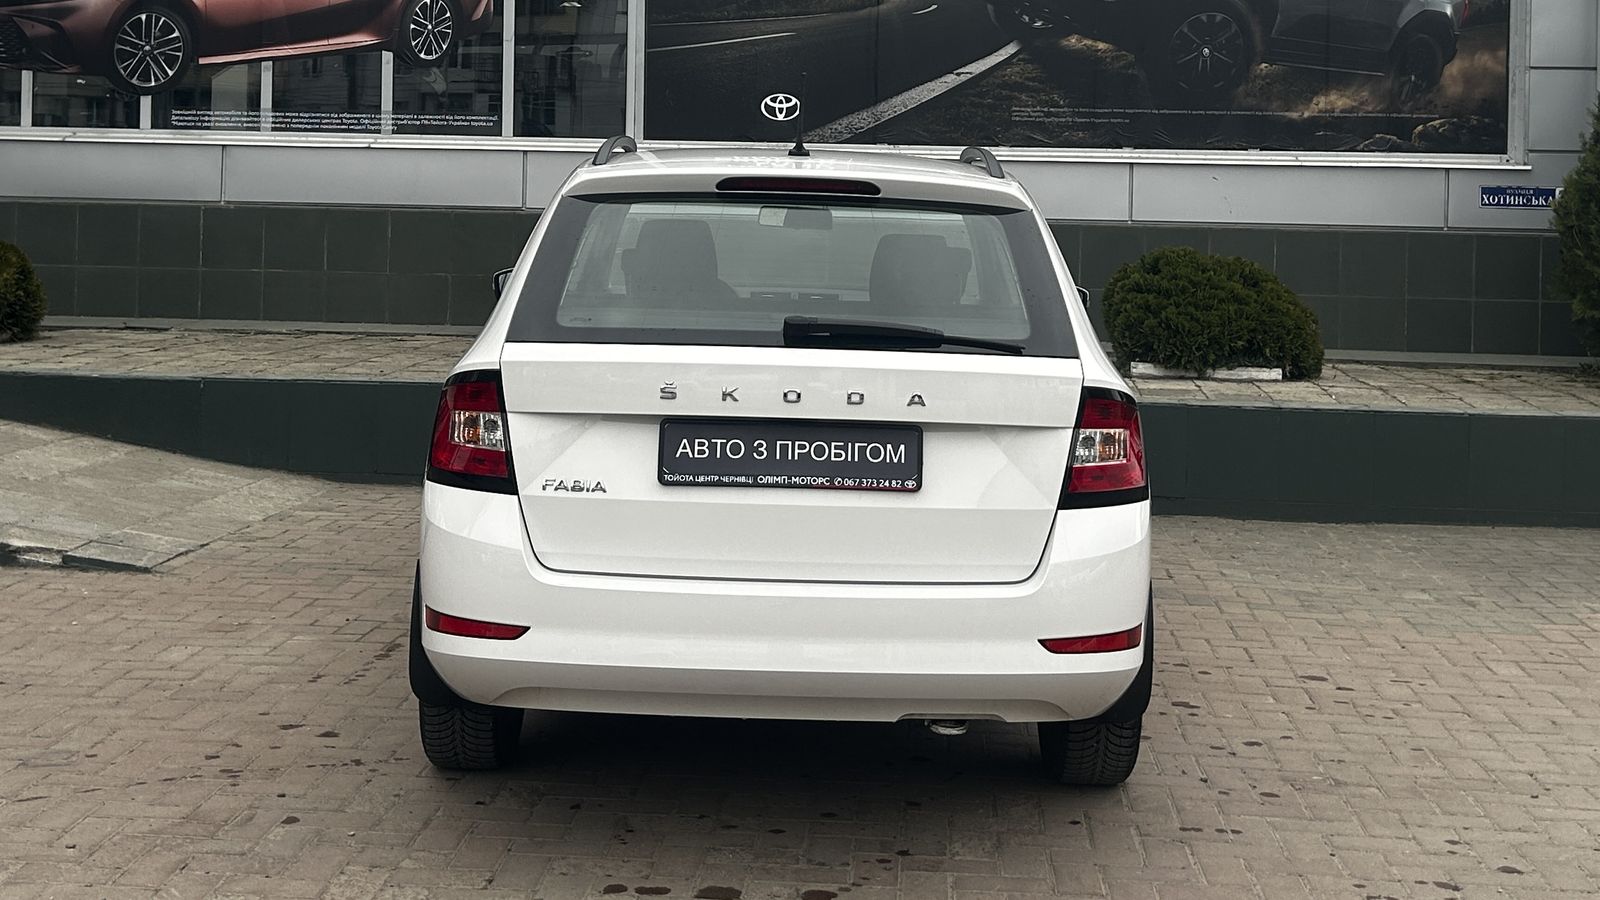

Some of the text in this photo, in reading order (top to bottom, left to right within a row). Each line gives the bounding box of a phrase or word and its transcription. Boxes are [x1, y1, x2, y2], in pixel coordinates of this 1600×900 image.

[1482, 194, 1553, 206] ХОТИНСЬКА
[660, 380, 926, 406] ŠKODA
[676, 438, 745, 459] АВТО
[776, 441, 906, 464] ПРОБІГОМ
[542, 479, 607, 493] FABIA
[664, 474, 902, 488] ТОЙОТА ЦЕНТР ЧЕРНІВЦІ ОЛІМП-МОТОРС 067 373 24 82
